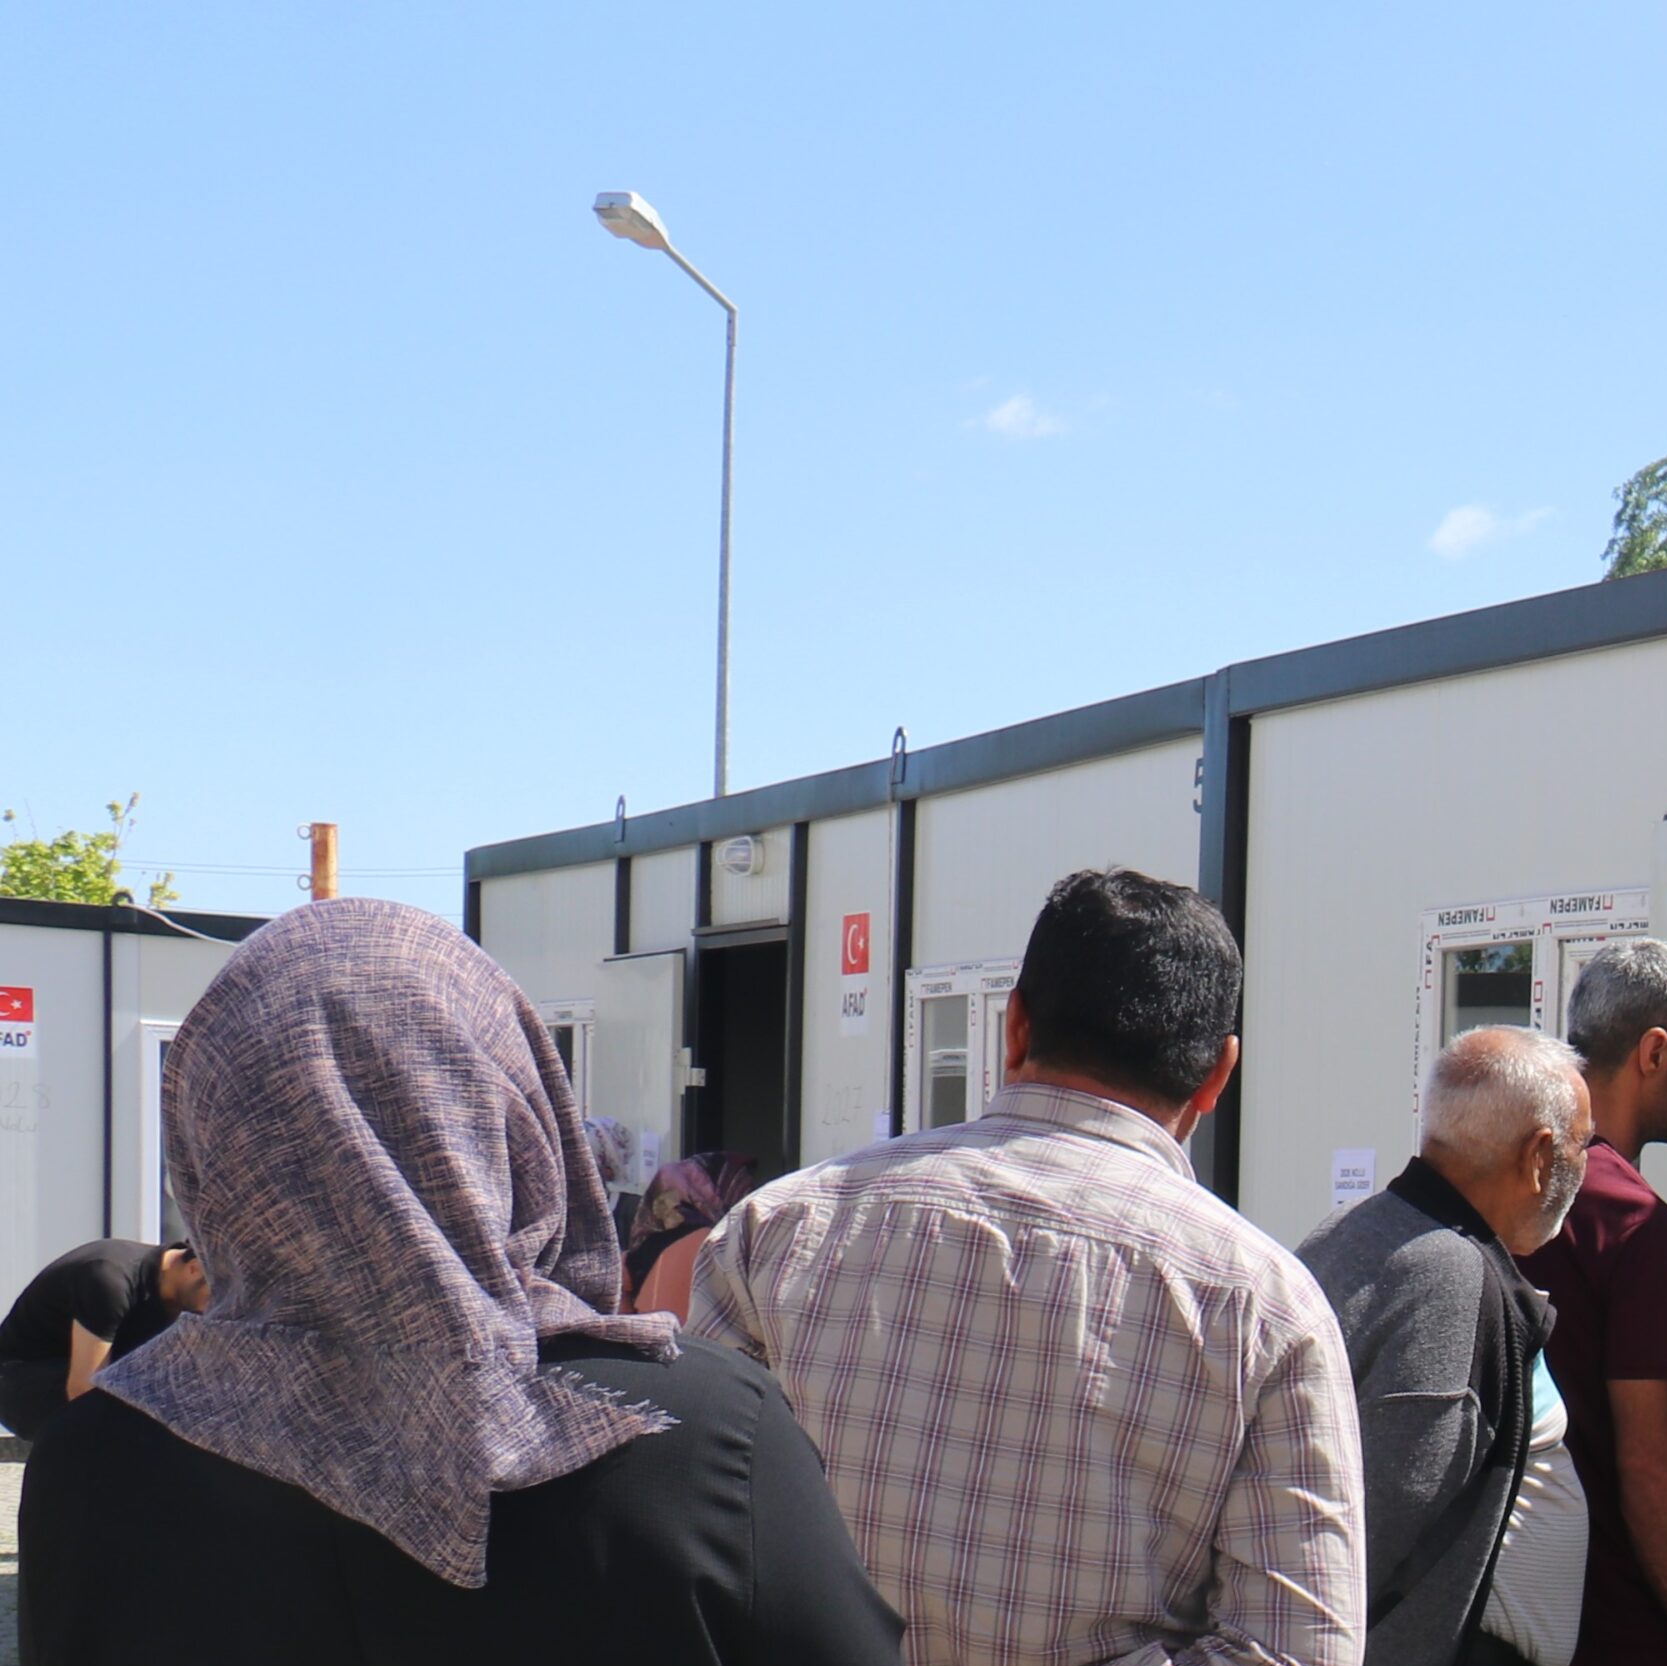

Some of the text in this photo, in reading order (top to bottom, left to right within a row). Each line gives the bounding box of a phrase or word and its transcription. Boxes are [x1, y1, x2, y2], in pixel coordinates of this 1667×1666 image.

[1550, 894, 1601, 914] FAMEPEN
[1438, 909, 1487, 927] FAMEPEN
[842, 992, 866, 1018] AFAD
[0, 1032, 27, 1047] AD
